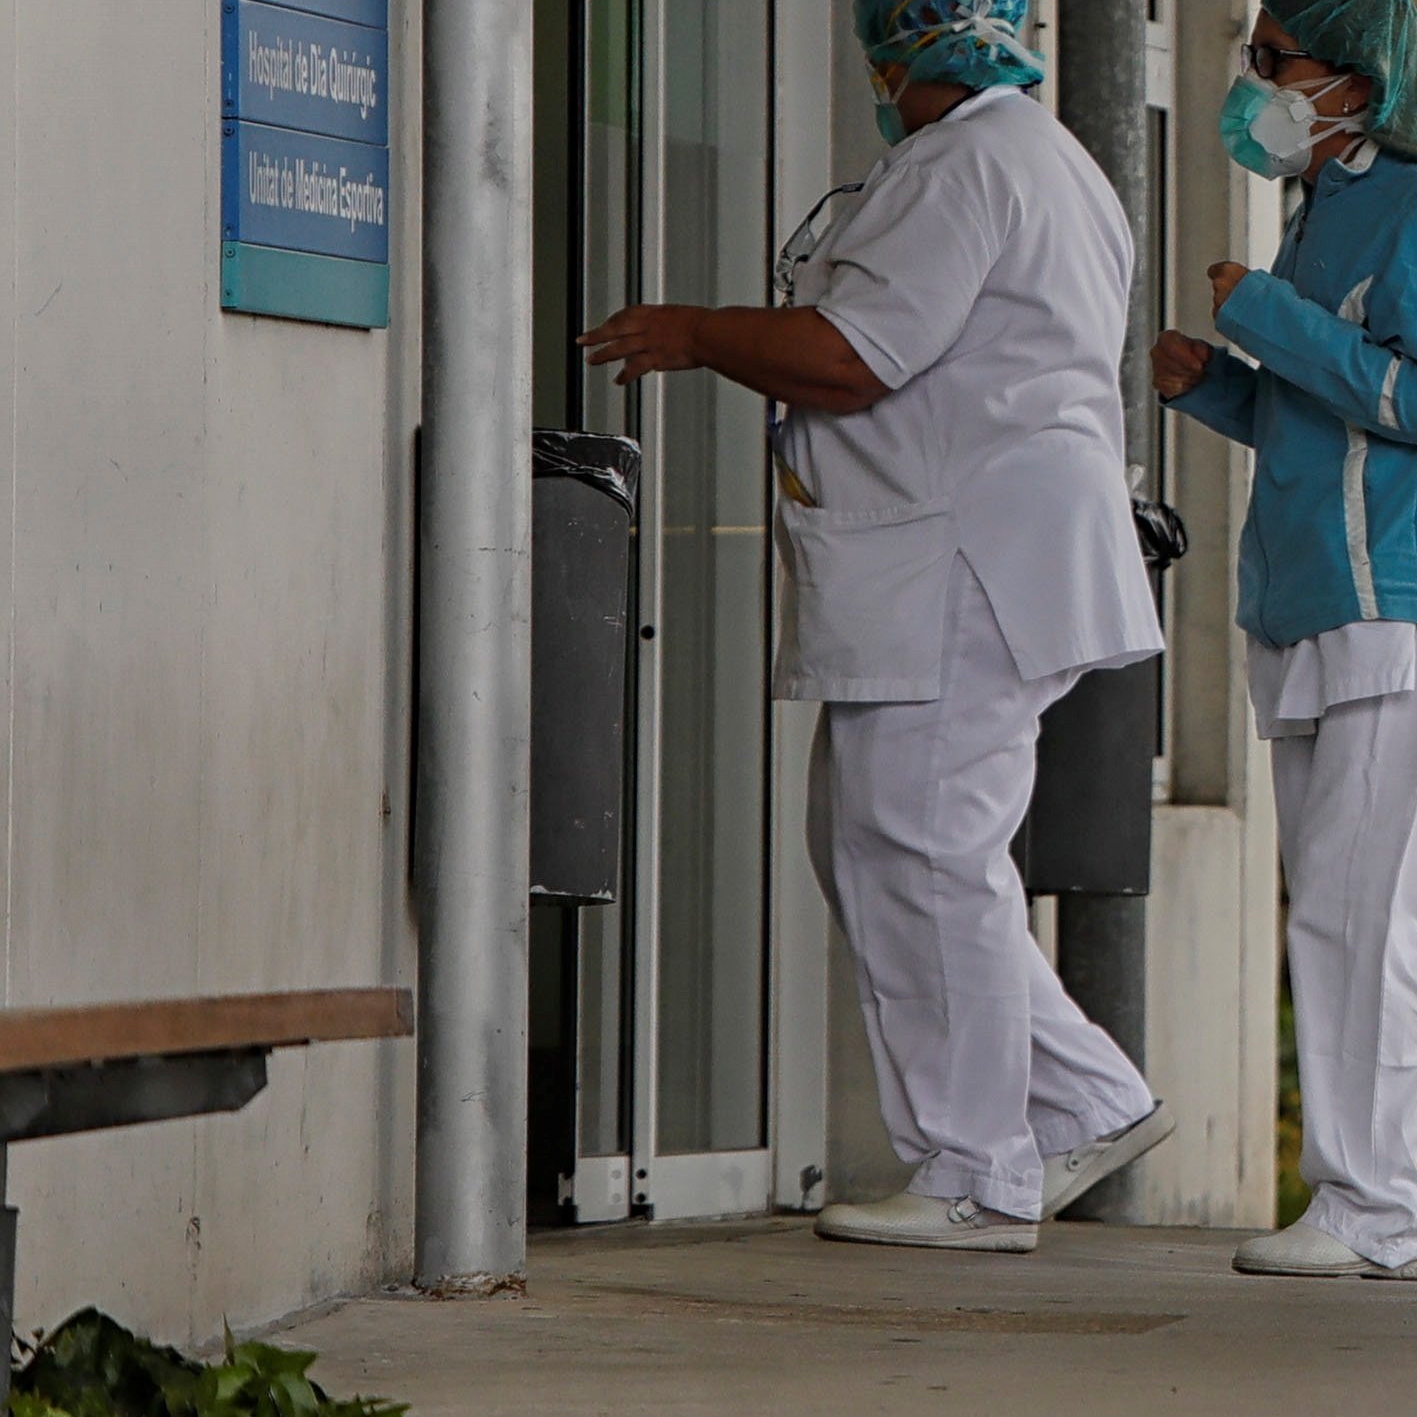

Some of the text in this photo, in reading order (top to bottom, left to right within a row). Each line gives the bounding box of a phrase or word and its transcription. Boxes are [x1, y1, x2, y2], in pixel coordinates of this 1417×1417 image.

[249, 30, 293, 100] Hospital
[294, 42, 308, 93] de
[329, 47, 377, 120] Quirúrgic
[249, 151, 383, 233] Unitat de Medicina Esportiva
